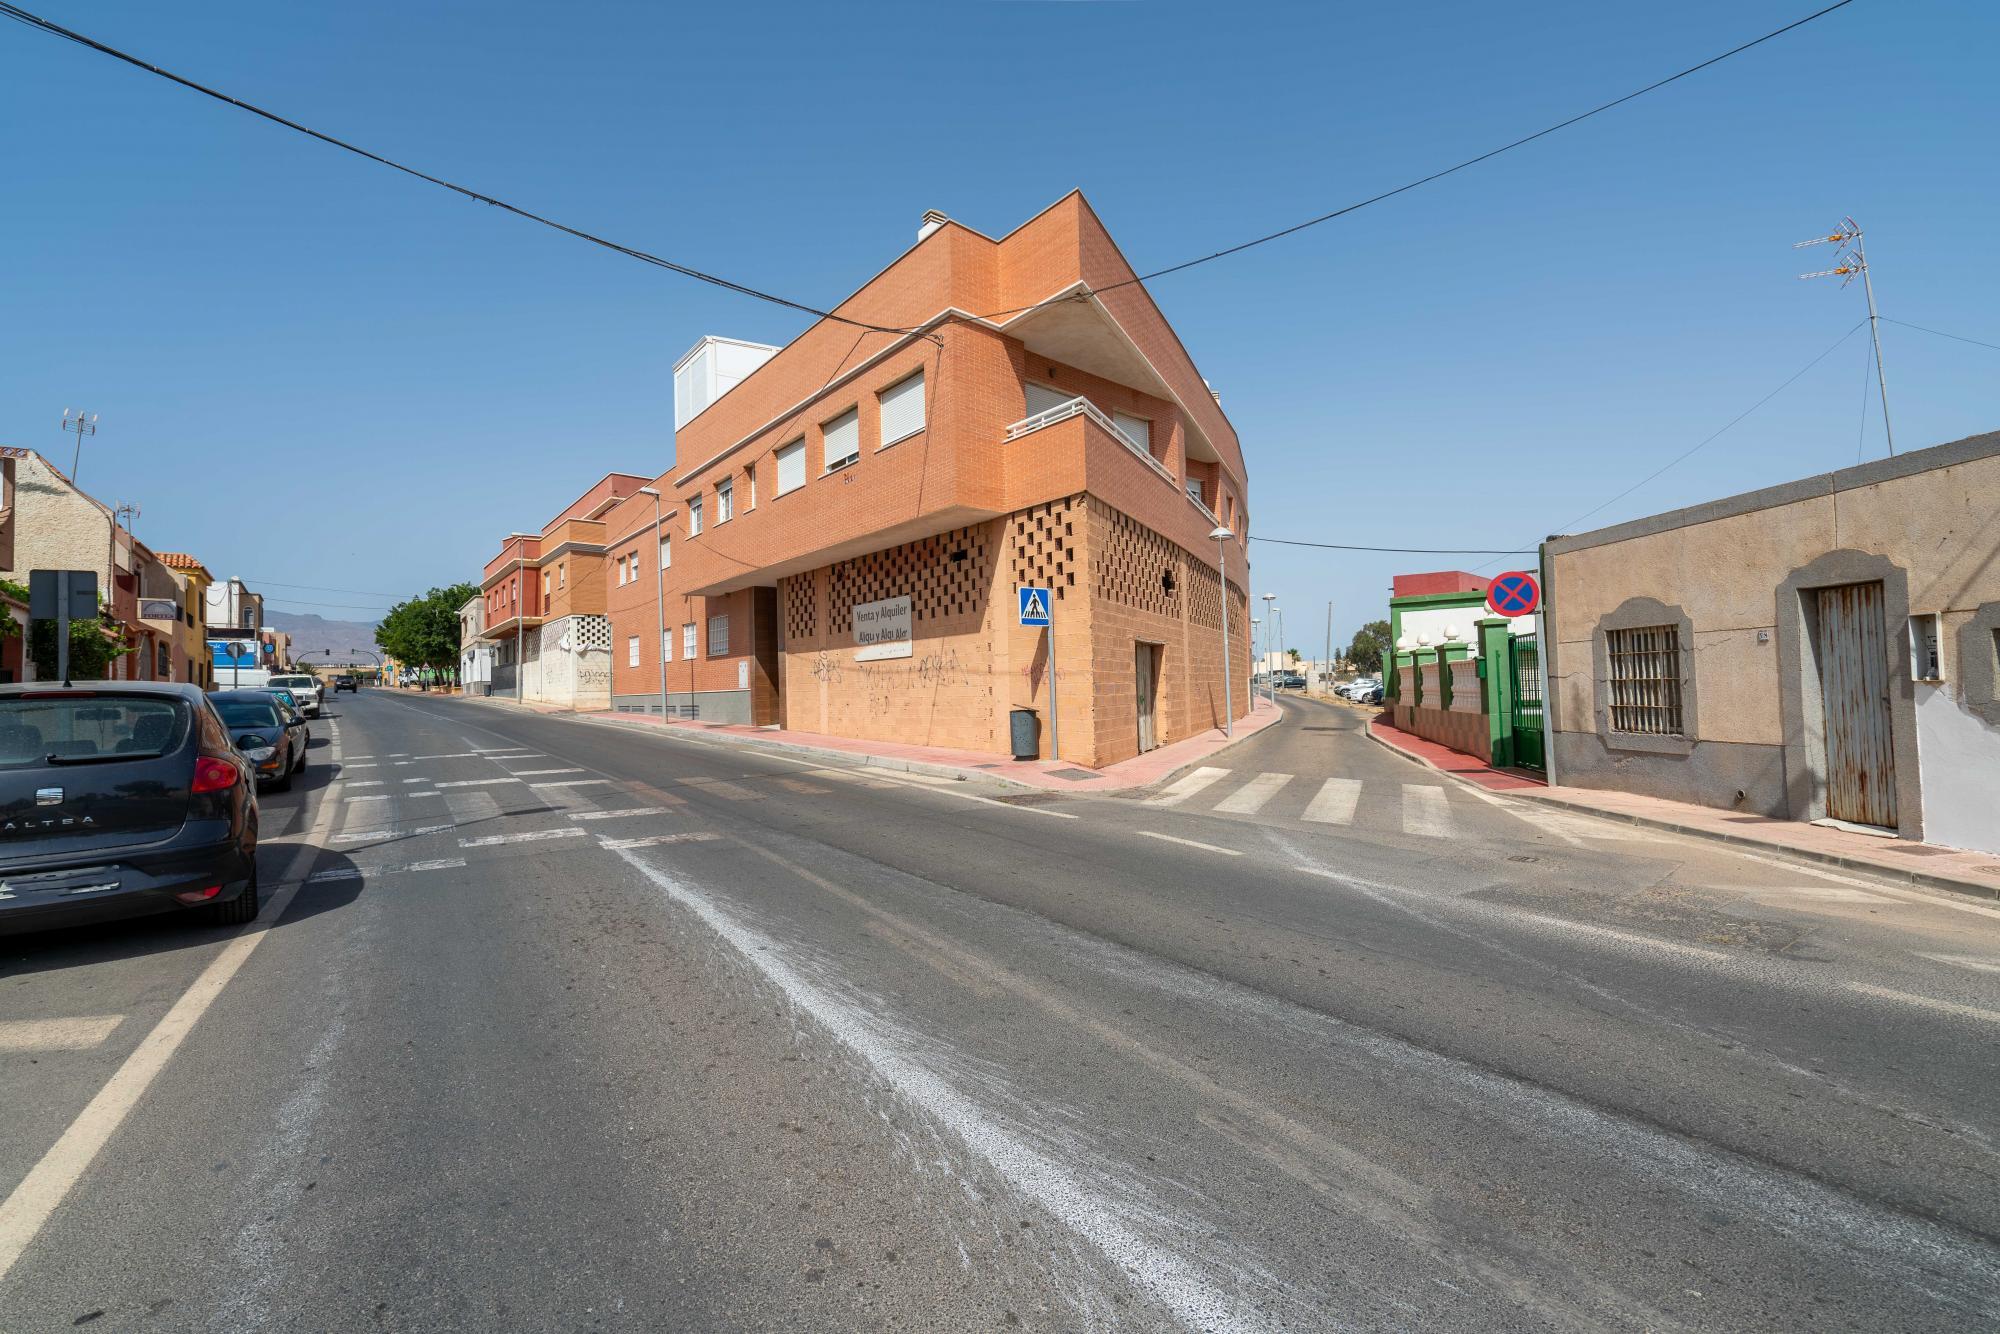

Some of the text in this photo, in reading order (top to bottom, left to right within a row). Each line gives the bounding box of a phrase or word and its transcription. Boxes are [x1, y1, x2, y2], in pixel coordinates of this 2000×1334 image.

[856, 604, 907, 623] Venta y Alquiler
